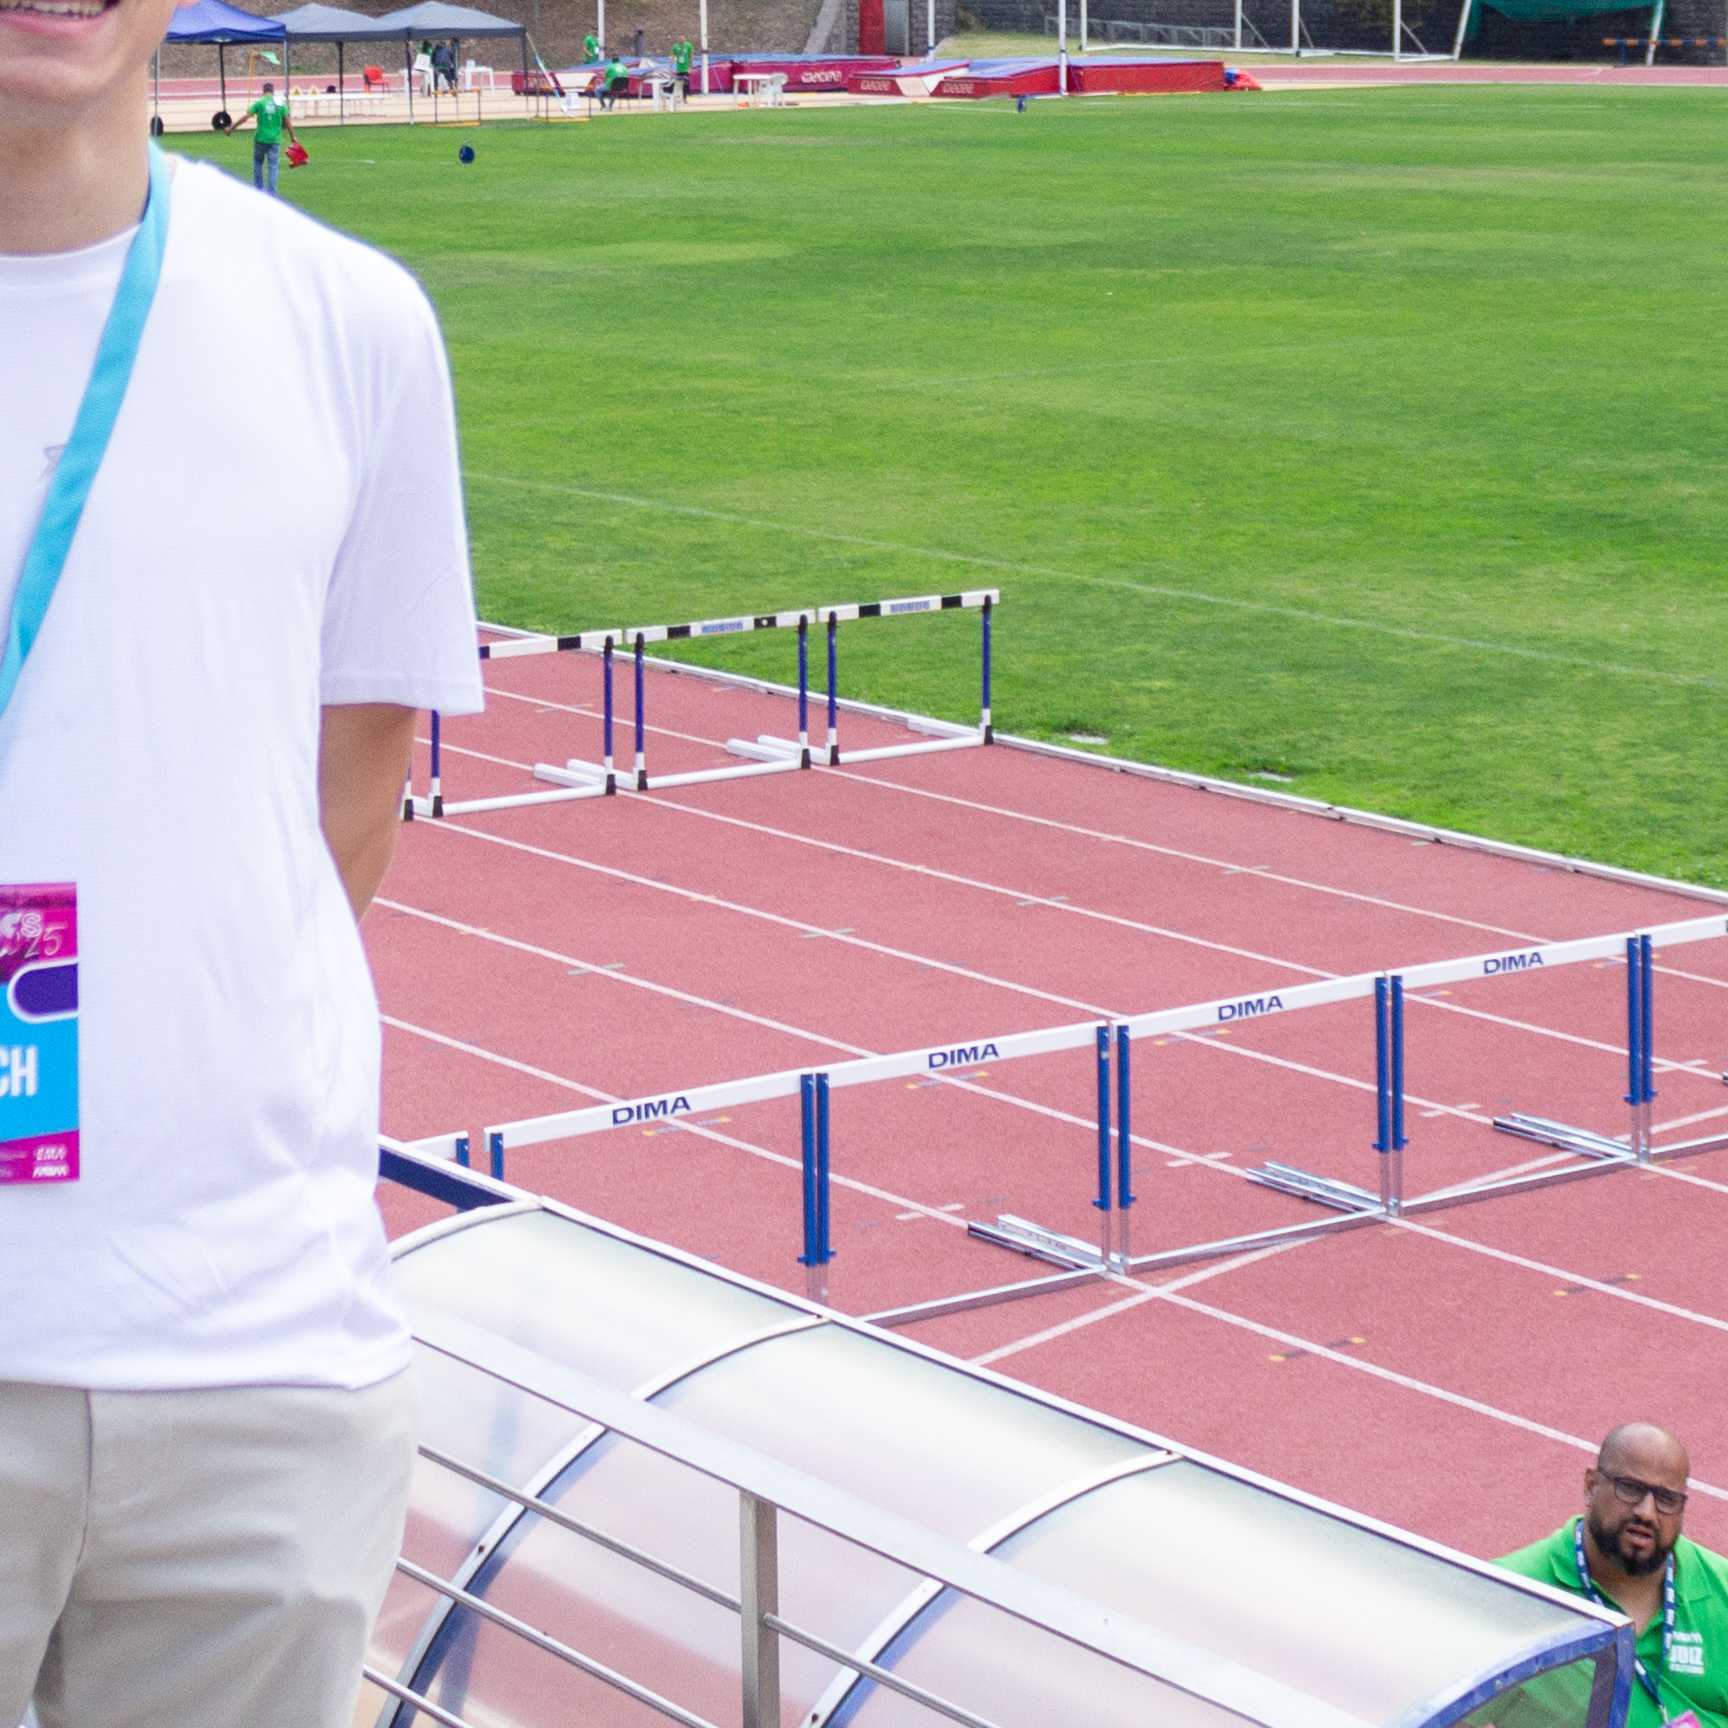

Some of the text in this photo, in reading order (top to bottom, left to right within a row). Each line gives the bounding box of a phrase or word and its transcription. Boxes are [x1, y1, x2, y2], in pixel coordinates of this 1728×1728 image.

[1484, 951, 1544, 975] DIMA
[1218, 995, 1283, 1021] DIMA
[928, 1043, 999, 1069] DIMA
[612, 1096, 691, 1125] DIMA
